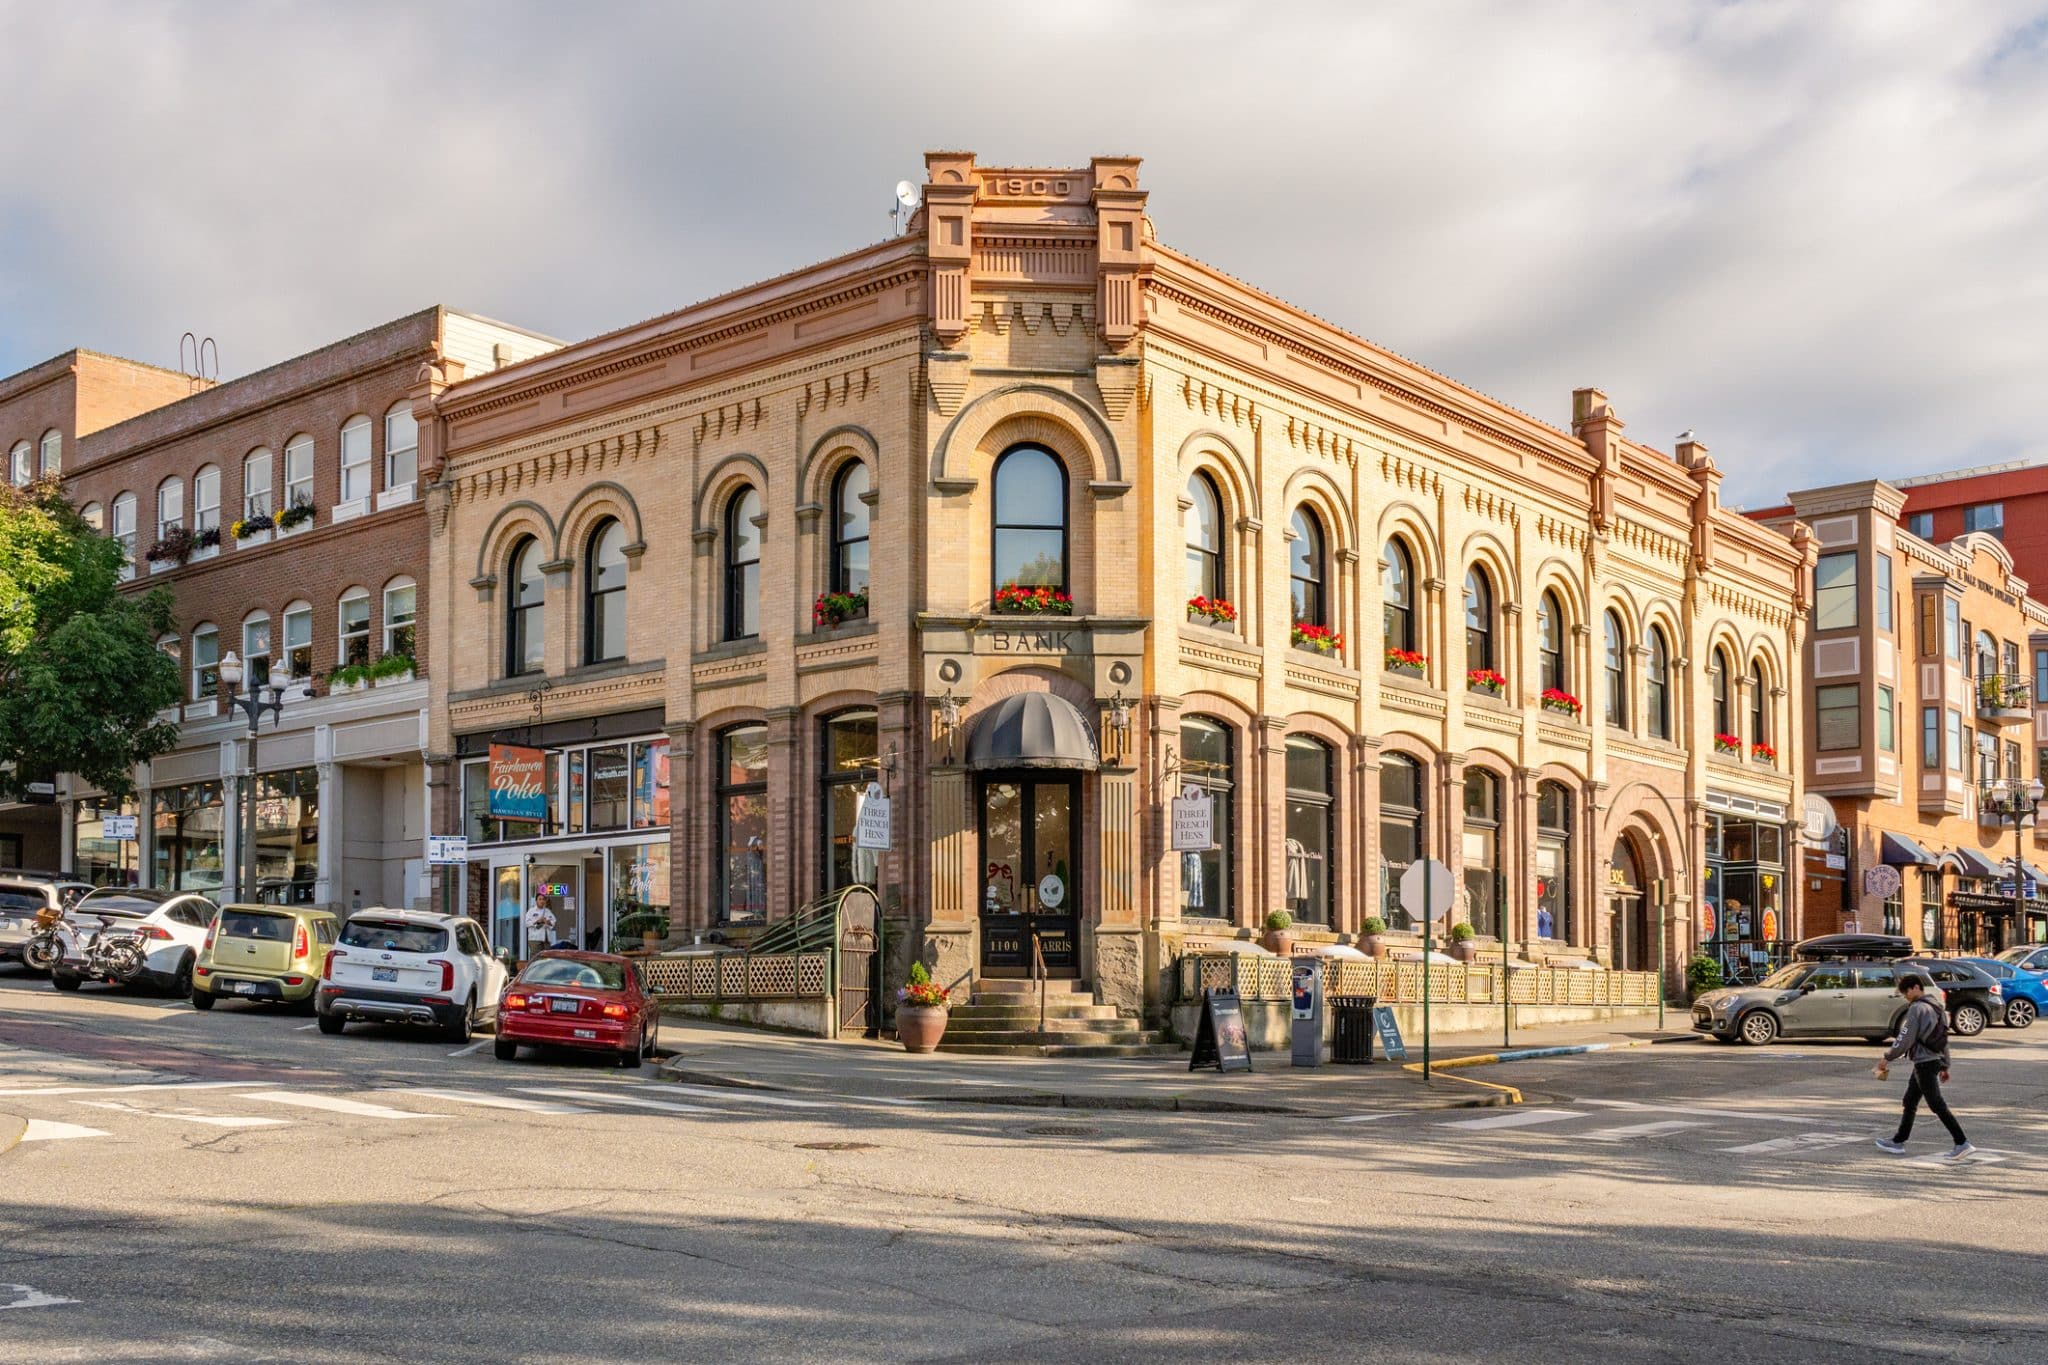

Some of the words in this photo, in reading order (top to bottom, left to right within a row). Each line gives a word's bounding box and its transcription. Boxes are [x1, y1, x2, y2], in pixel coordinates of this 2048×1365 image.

[995, 178, 1071, 195] 1900
[993, 631, 1073, 652] BANK
[491, 758, 543, 774] Fairhaven
[494, 772, 543, 800] Poke
[493, 808, 525, 816] HAWAIIAN
[863, 806, 887, 818] THREE
[1176, 809, 1207, 819] THREE
[860, 818, 889, 829] FRENCH
[1175, 820, 1209, 829] FRENCH
[864, 829, 885, 839] HENS
[1180, 831, 1204, 840] HENS
[539, 883, 569, 896] OPEN
[991, 940, 1019, 952] 1100
